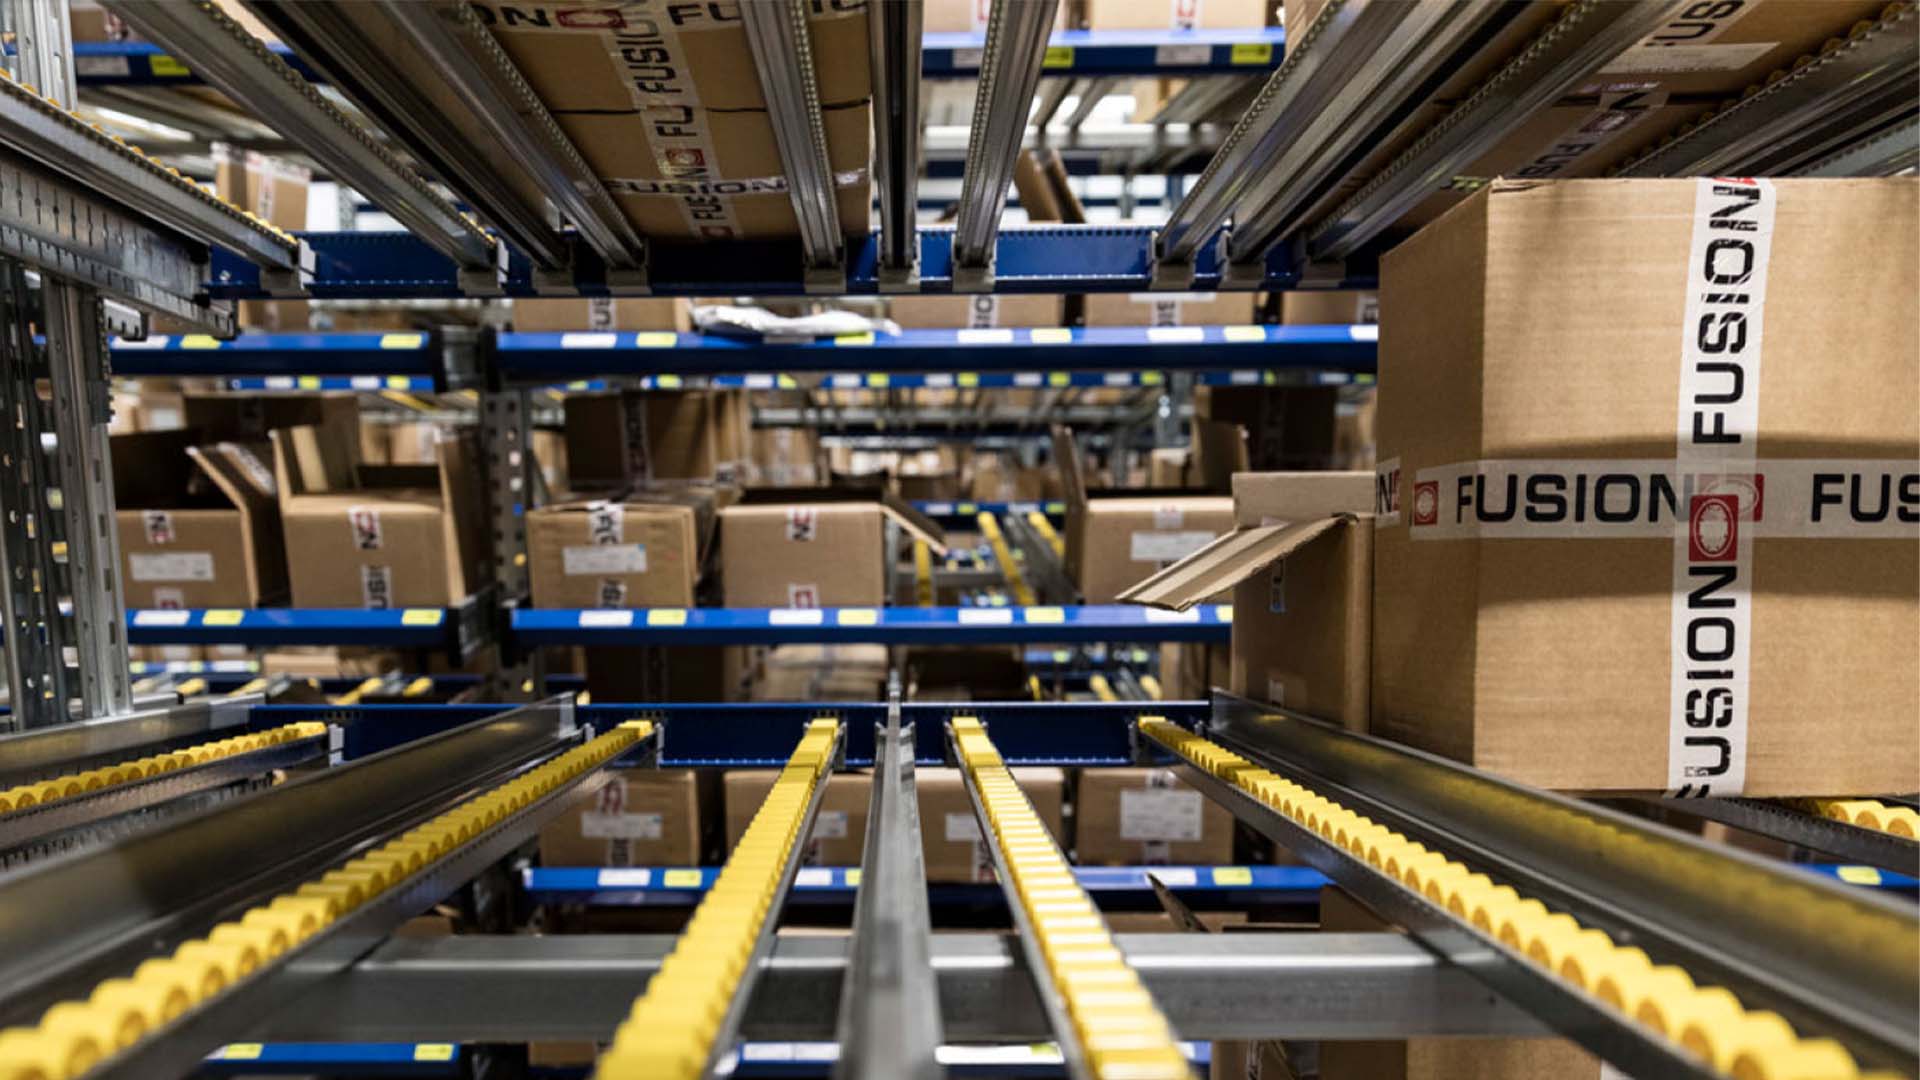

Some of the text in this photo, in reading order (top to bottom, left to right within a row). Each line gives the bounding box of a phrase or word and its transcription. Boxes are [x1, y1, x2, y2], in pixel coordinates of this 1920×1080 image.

[1644, 0, 1745, 47] US
[1693, 185, 1761, 444] FUSION
[1456, 473, 1694, 524] FUSION
[1811, 473, 1920, 523] FUS
